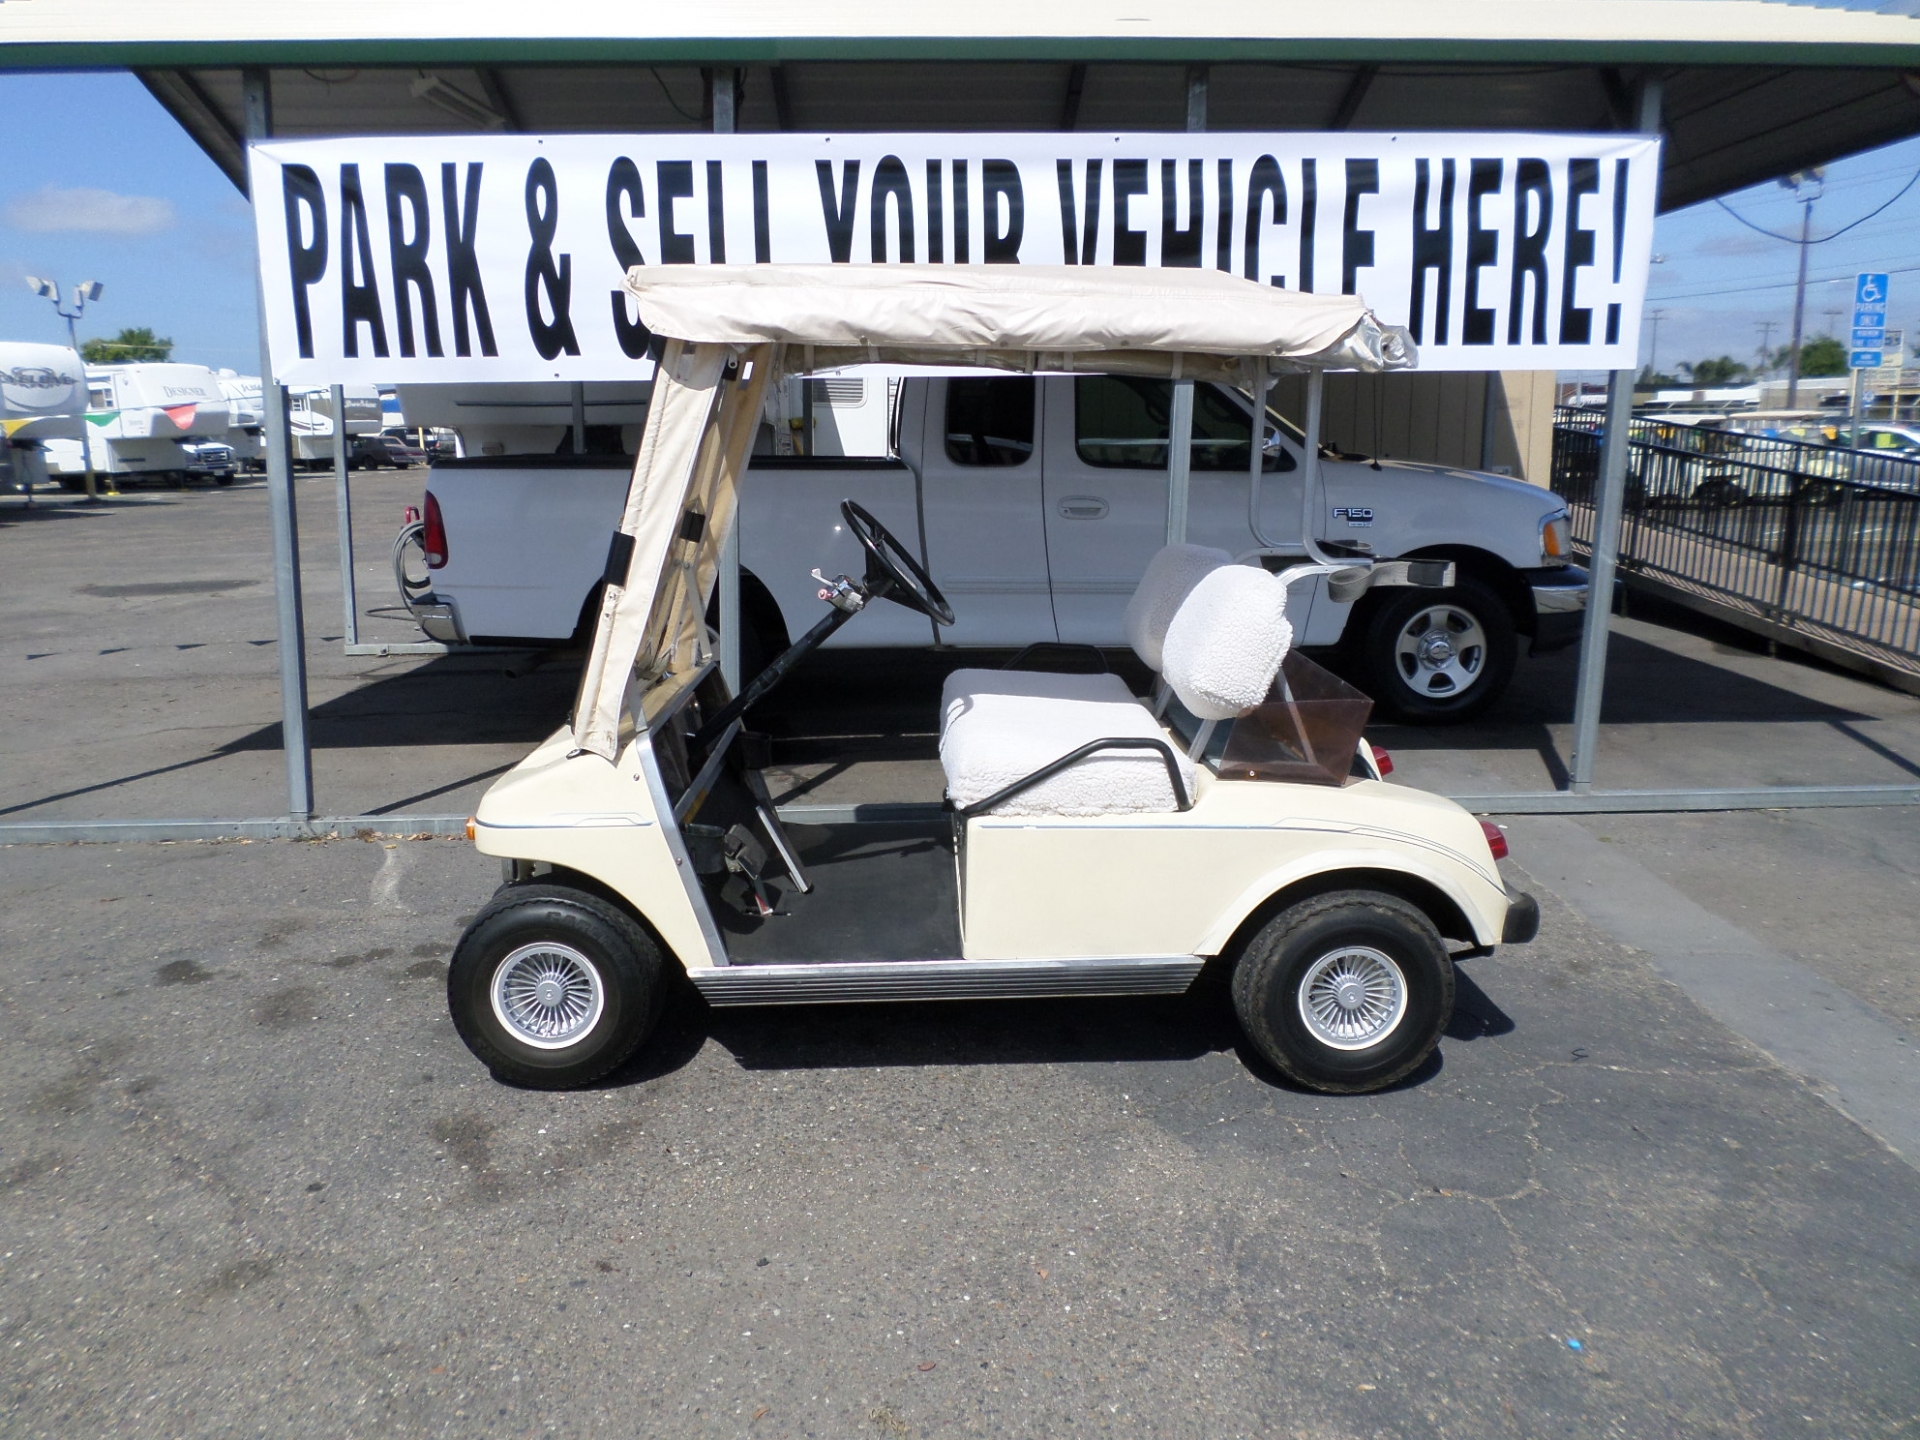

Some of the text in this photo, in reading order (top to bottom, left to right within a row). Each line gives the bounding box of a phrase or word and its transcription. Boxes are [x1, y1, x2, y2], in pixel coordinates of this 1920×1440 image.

[282, 162, 499, 358] PARK
[525, 157, 581, 361] &
[1056, 154, 1380, 295] VEHICLE
[1408, 158, 1629, 346] HERE!
[163, 386, 207, 398] DESIGNER
